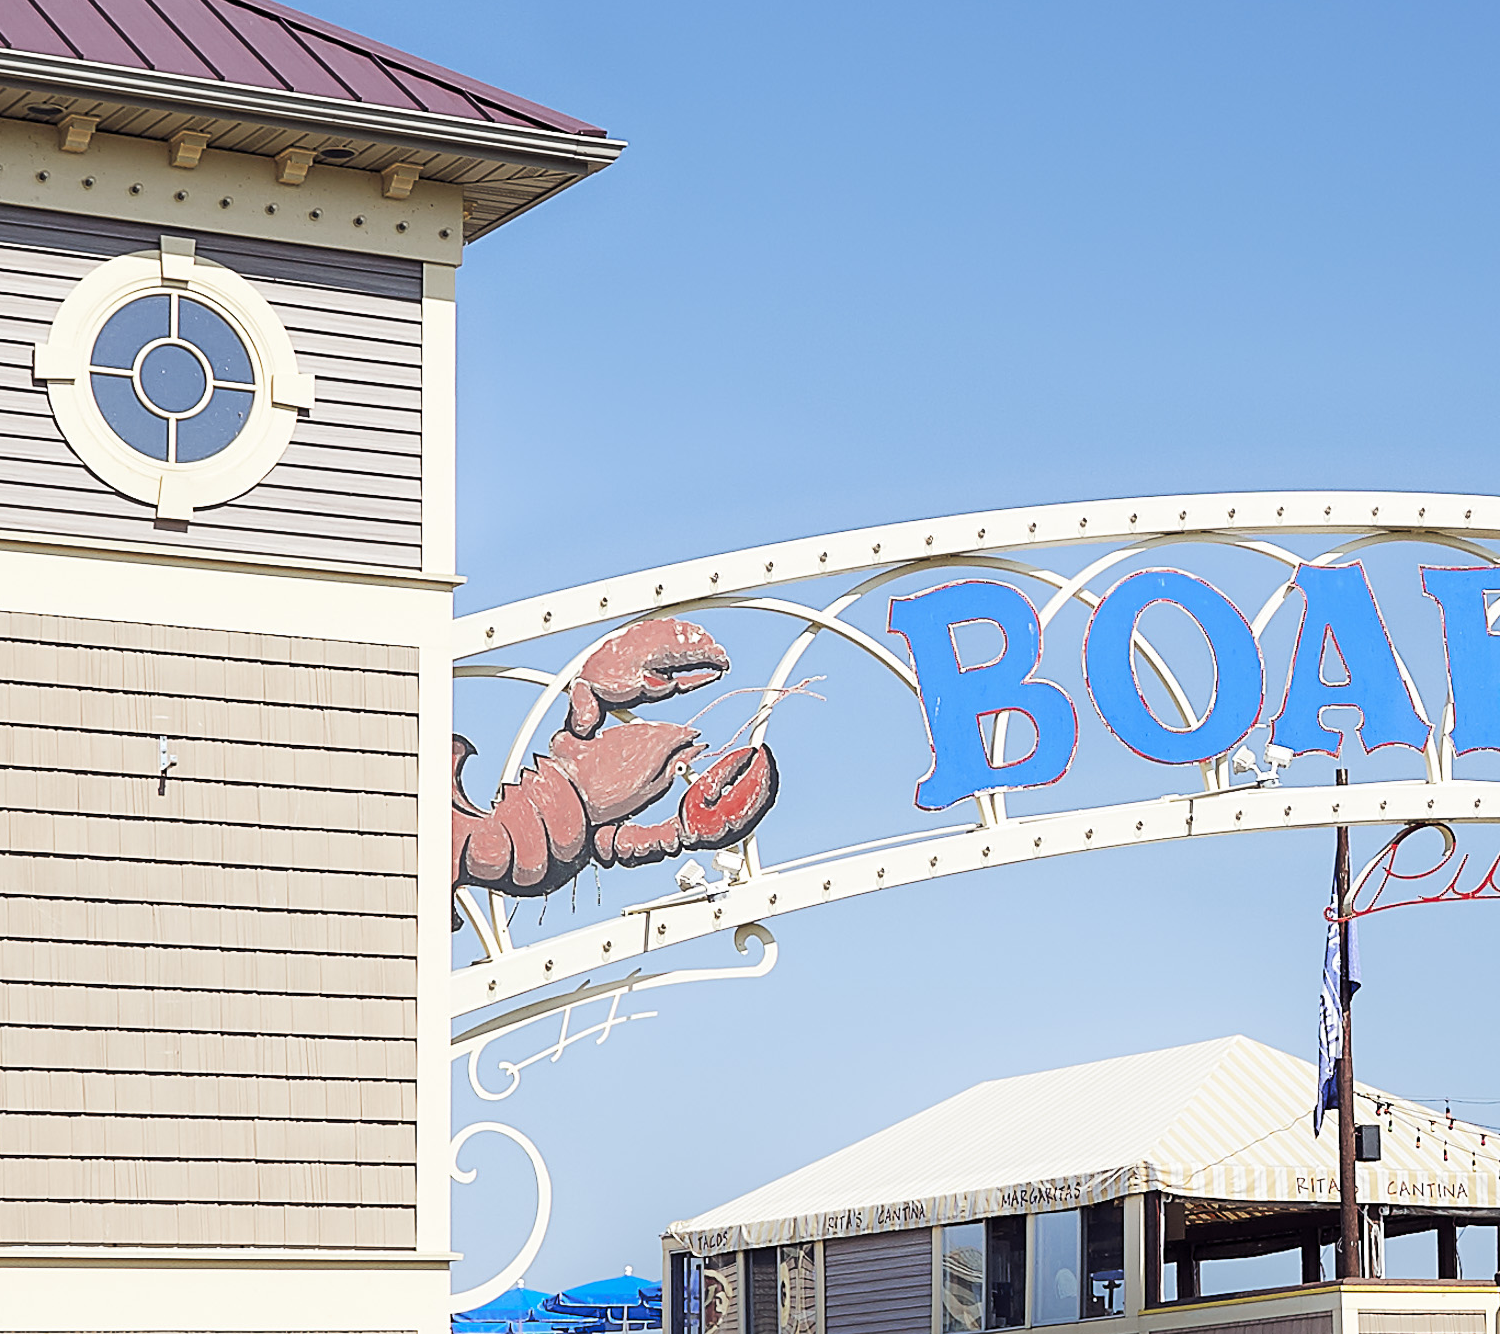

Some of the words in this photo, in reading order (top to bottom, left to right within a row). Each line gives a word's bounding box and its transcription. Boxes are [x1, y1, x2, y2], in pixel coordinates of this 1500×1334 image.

[1000, 1181, 1082, 1209] MARGARITAS
[1387, 1180, 1469, 1199] CANTINA
[826, 1208, 864, 1234] RITA'S
[875, 1199, 927, 1226] CANTINA
[697, 1230, 729, 1249] TACOS
